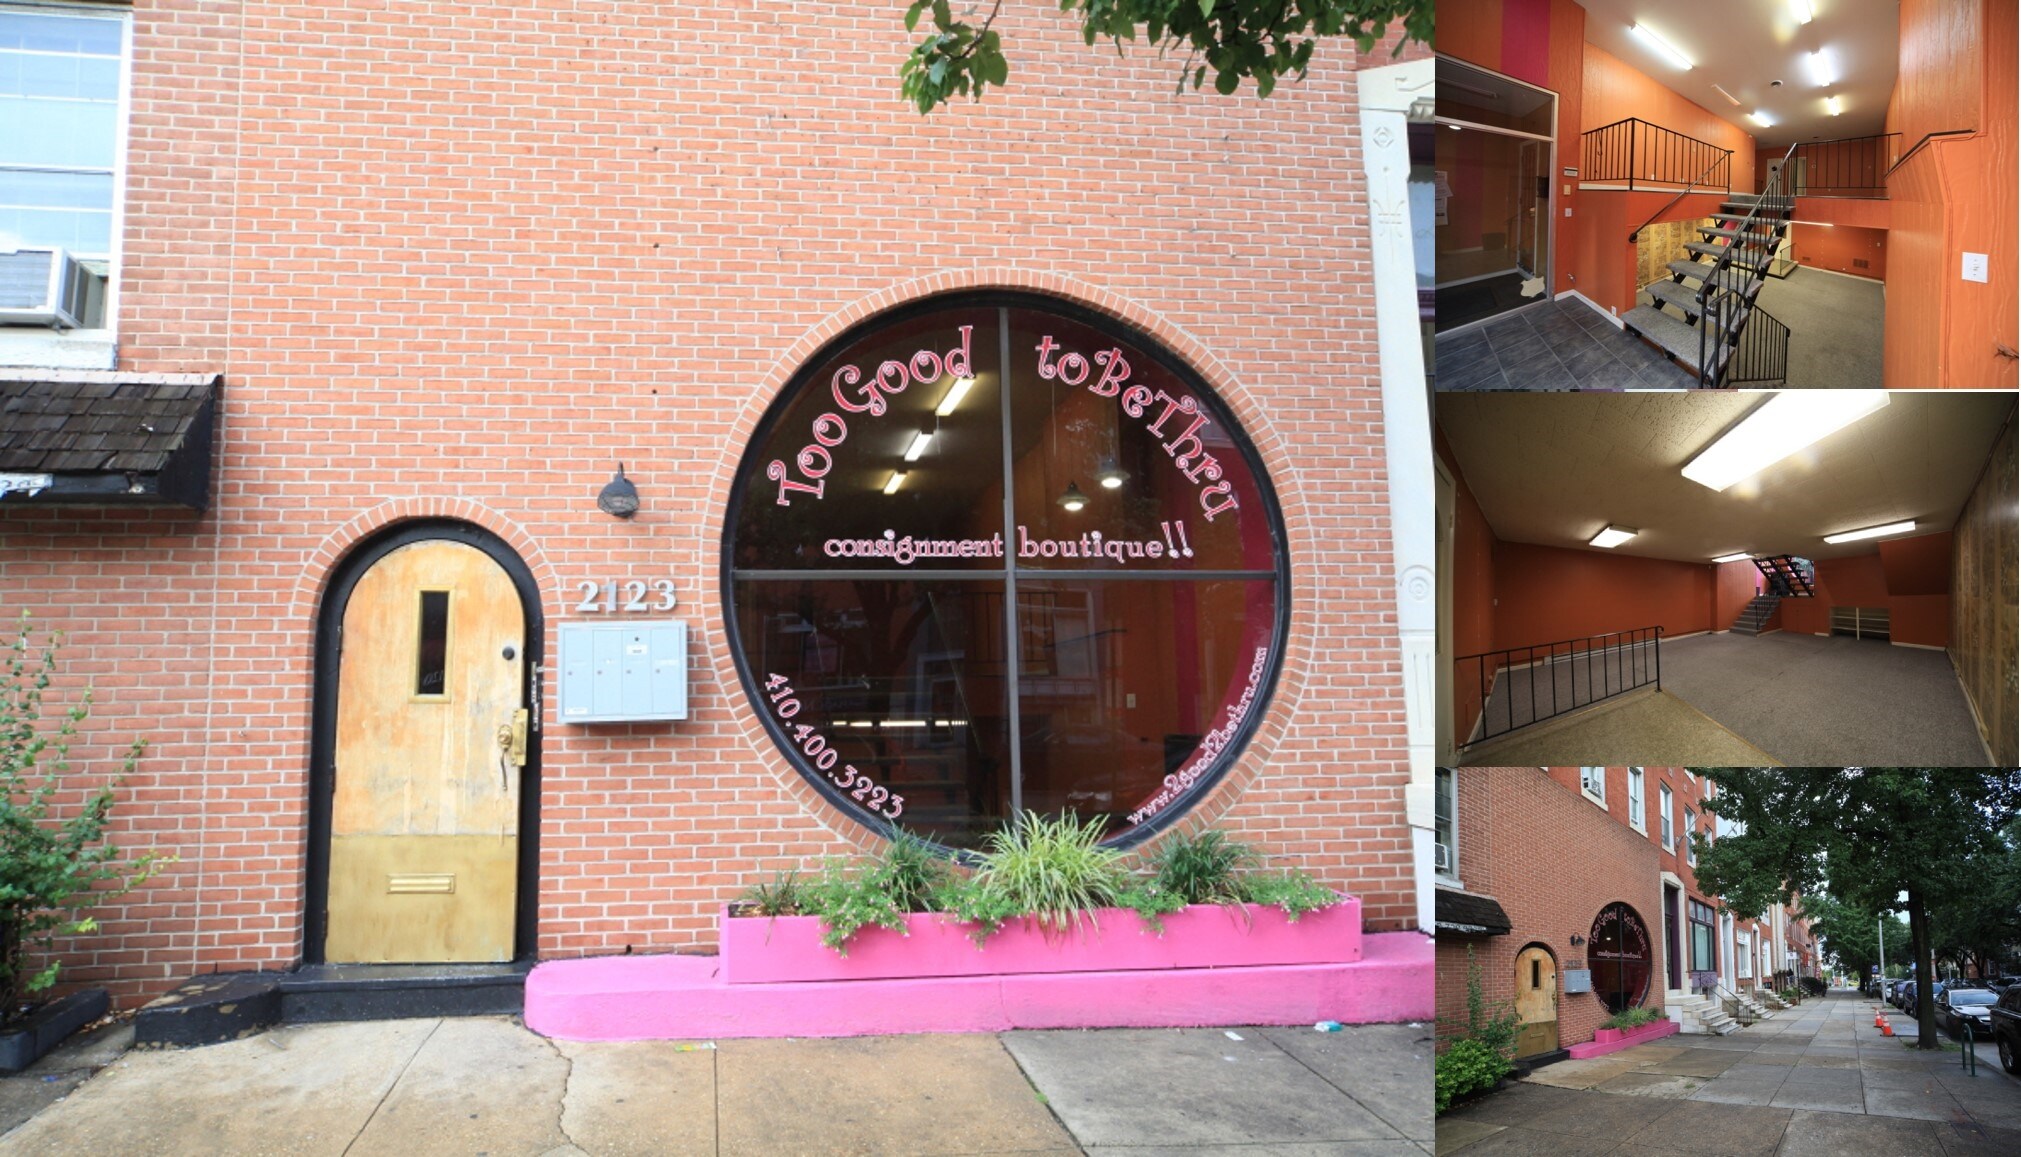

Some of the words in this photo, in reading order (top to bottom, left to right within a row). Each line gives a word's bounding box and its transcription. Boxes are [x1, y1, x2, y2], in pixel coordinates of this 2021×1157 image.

[823, 529, 1004, 565] consignment
[1017, 520, 1194, 564] boutique!!
[575, 579, 677, 612] 2123
[764, 672, 905, 819] 410.400.3223
[1126, 646, 1268, 826] www.2good2bethru.com
